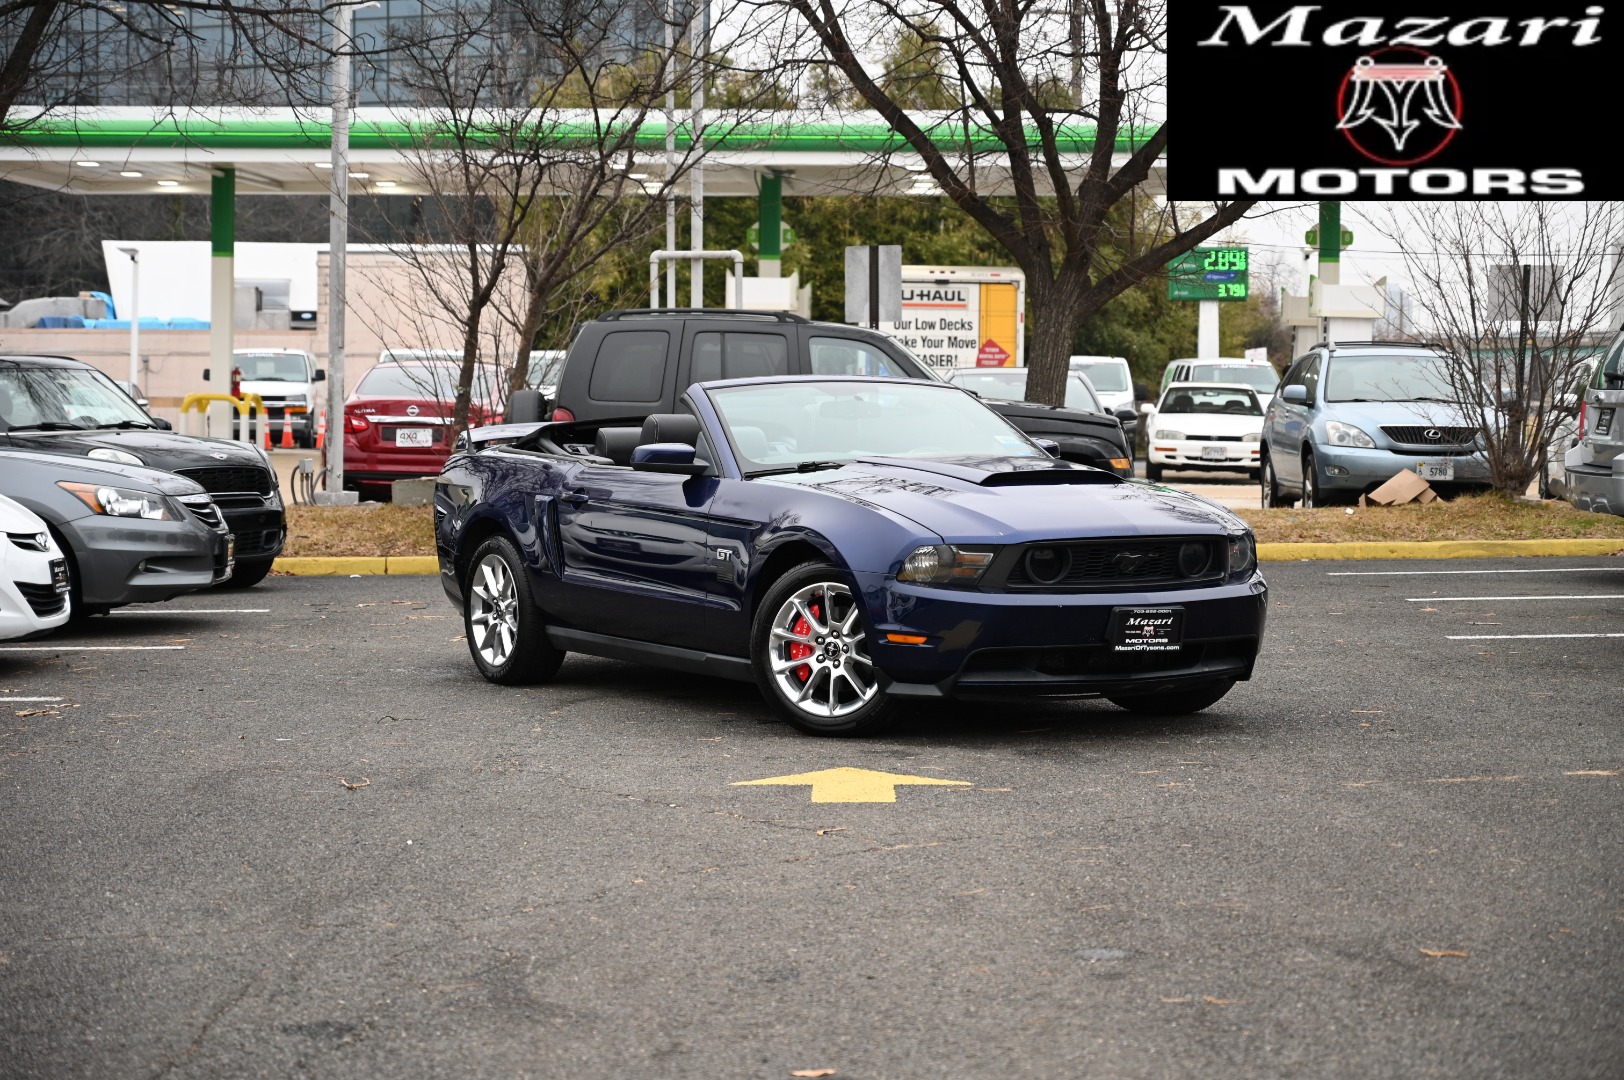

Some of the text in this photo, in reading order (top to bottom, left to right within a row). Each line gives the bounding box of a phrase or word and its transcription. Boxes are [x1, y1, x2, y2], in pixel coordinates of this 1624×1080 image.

[901, 289, 966, 302] U-HAUL
[893, 317, 973, 331] Our Low Decks
[893, 335, 977, 349] ake Your Move
[916, 354, 958, 367] ASIER!
[716, 548, 733, 562] GT
[1125, 617, 1173, 625] Mazari
